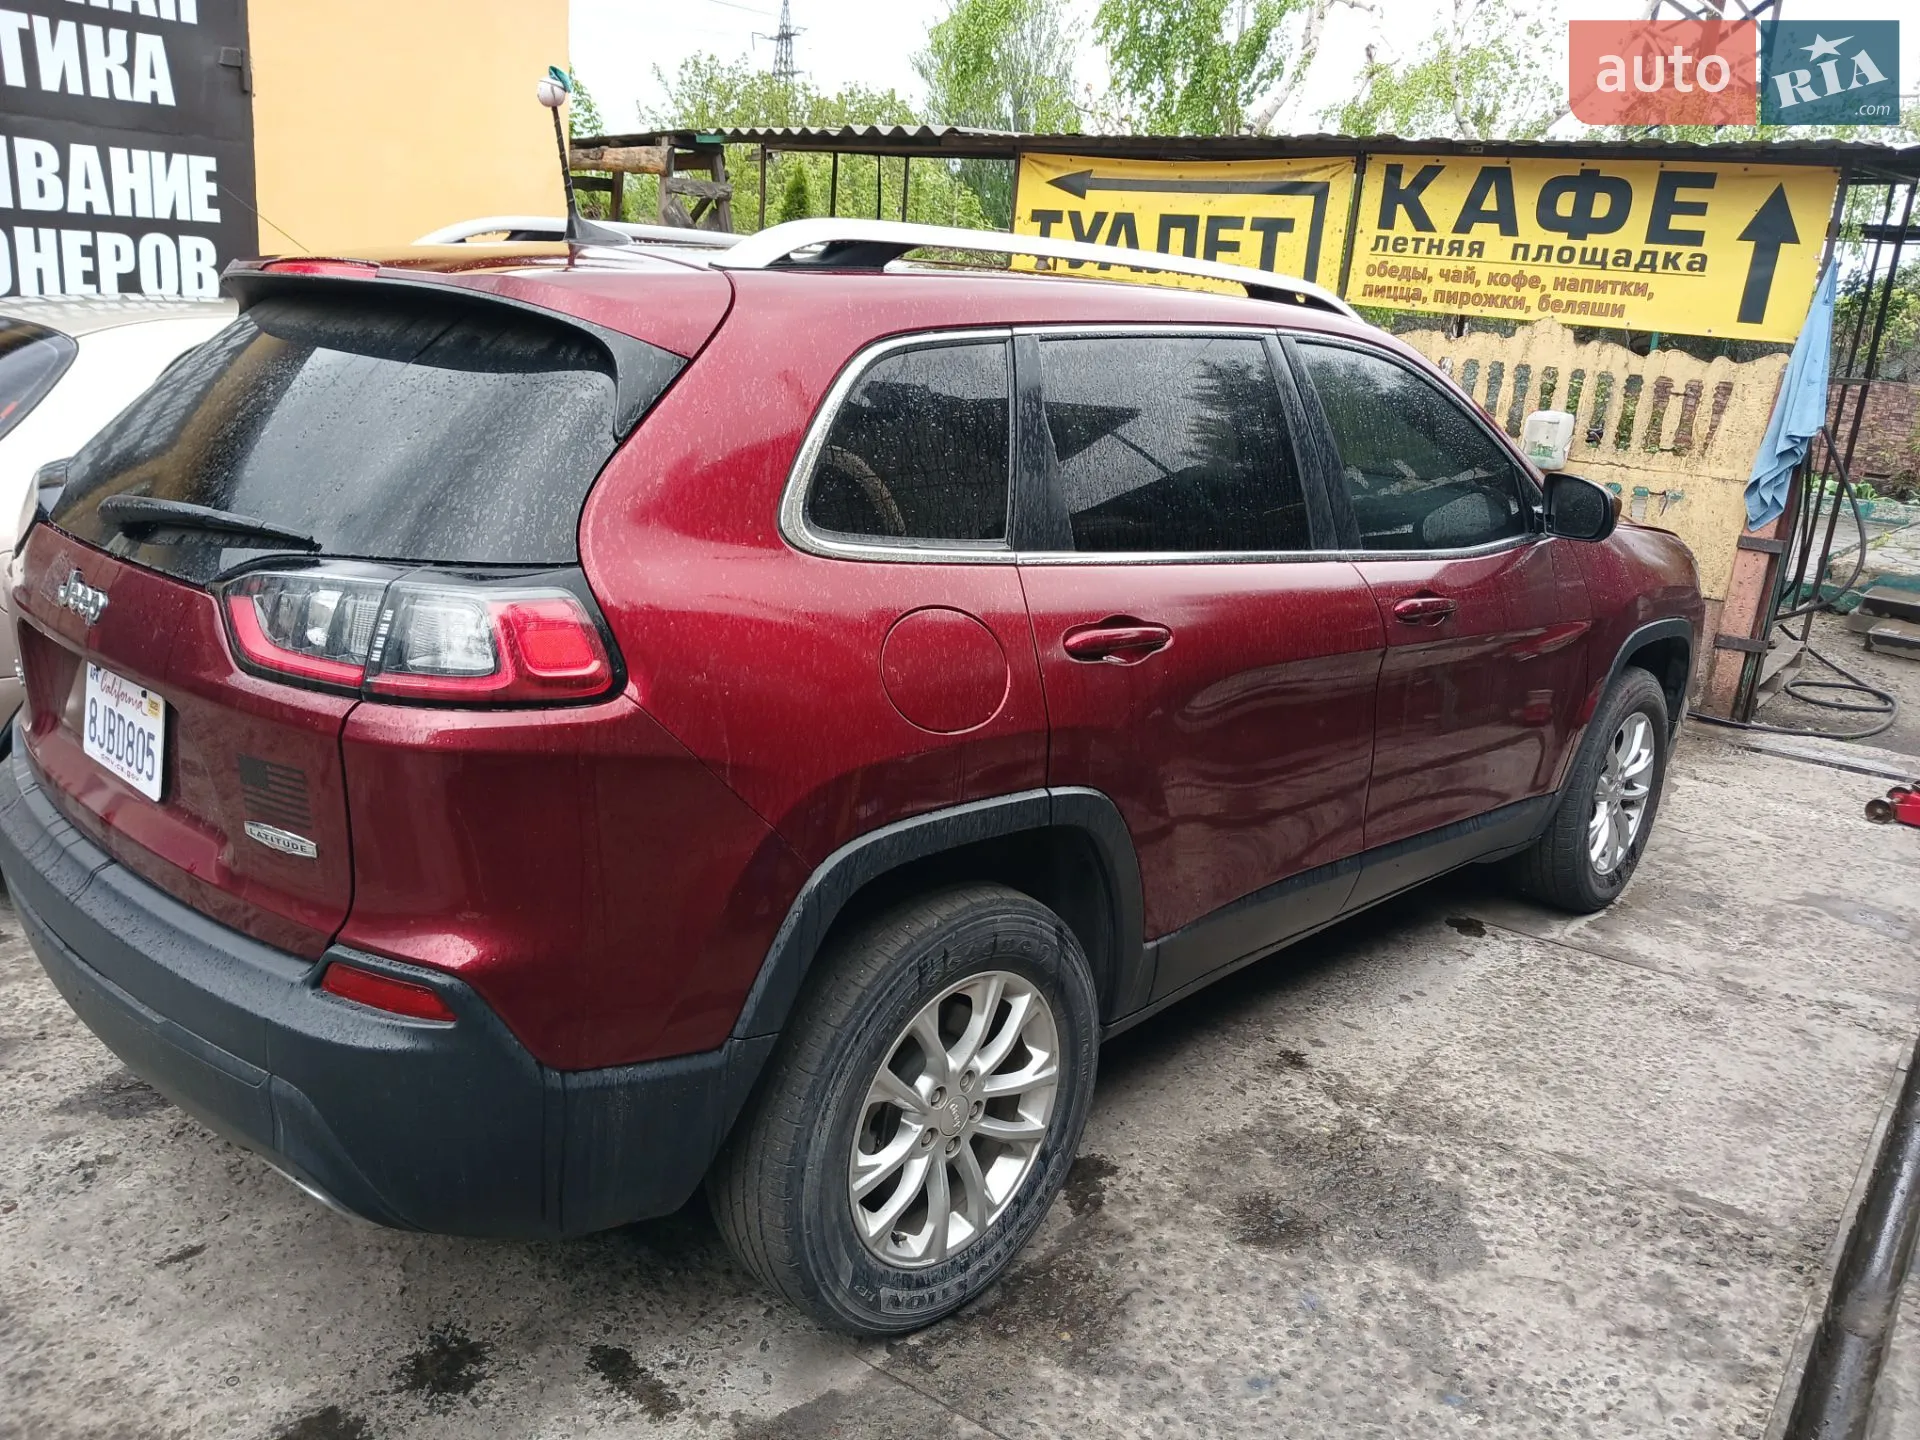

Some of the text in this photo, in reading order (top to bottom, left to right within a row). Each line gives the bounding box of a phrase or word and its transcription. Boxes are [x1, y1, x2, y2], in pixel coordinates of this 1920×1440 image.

[1377, 163, 1718, 247] КАФЕ
[1370, 234, 1708, 273] летняя площадка
[1362, 283, 1626, 318] пицца, пирожки, беляши
[1365, 261, 1655, 301] обеды, чай, кофе, напитки,
[101, 670, 148, 716] California
[89, 697, 156, 781] 8JBD805
[249, 827, 308, 853] LATITUDE
